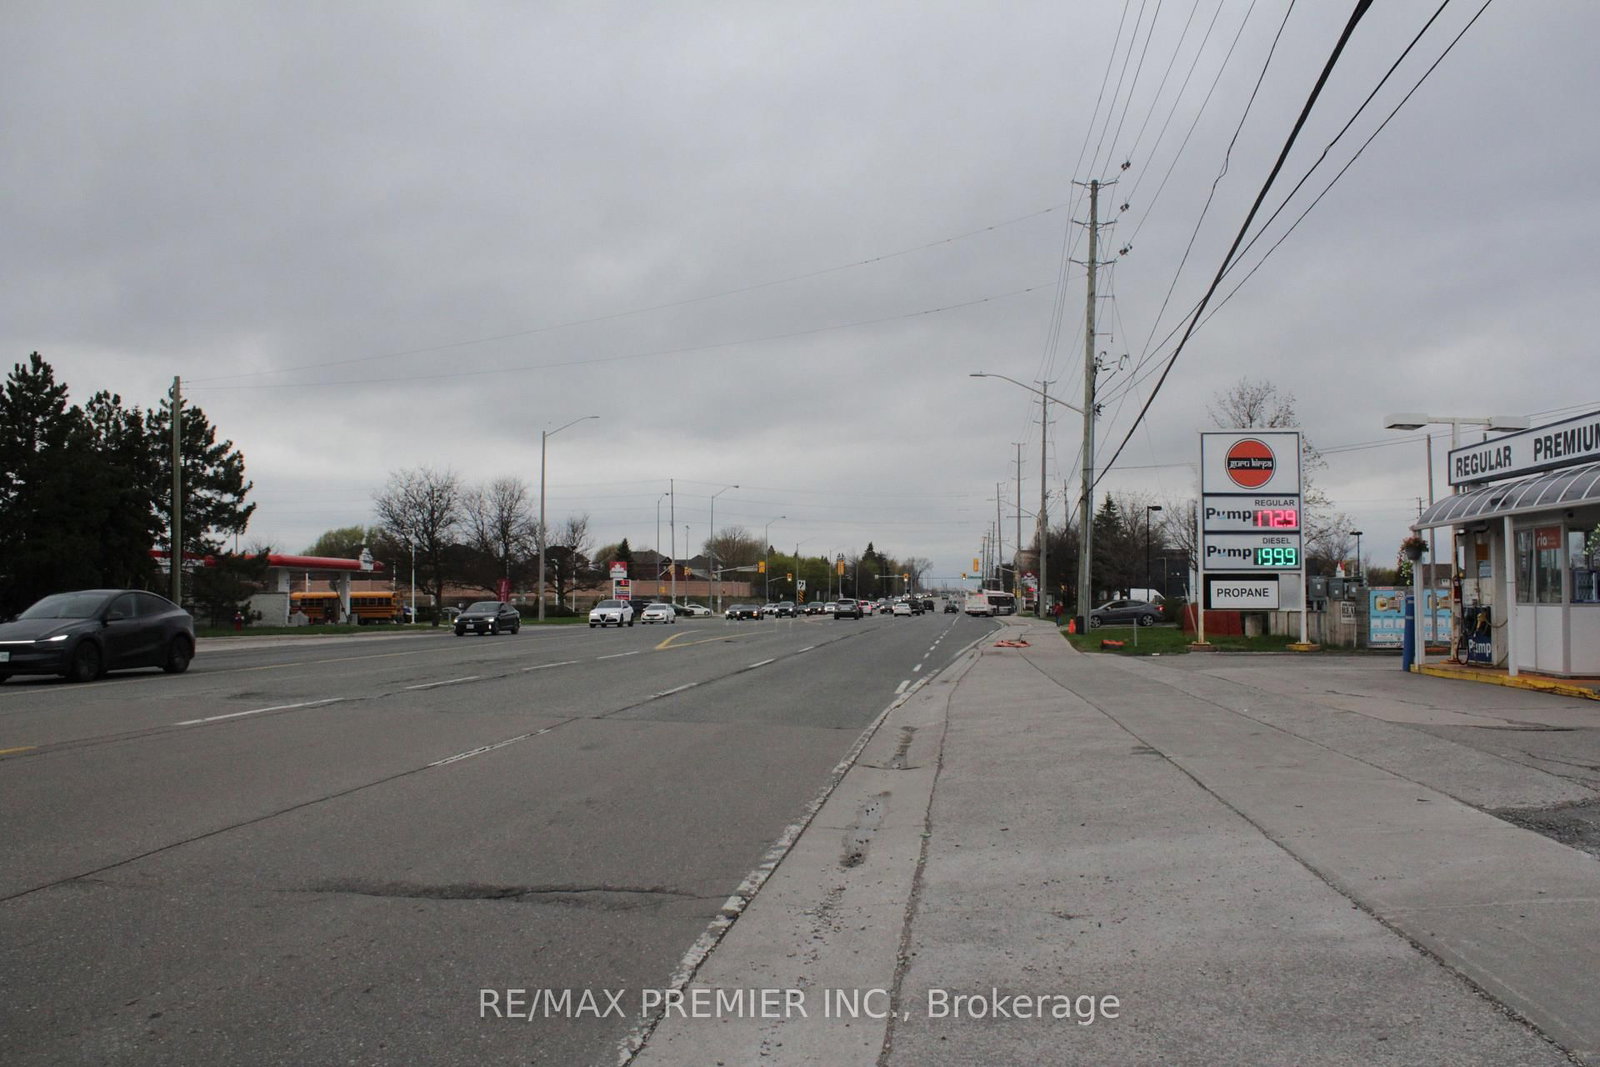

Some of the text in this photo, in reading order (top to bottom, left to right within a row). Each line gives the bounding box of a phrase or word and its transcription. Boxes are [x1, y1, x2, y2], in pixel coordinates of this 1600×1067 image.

[1456, 445, 1512, 477] REGULAR
[1206, 507, 1252, 522] Pump
[1207, 545, 1252, 560] Pump
[1216, 587, 1270, 597] PROPANE
